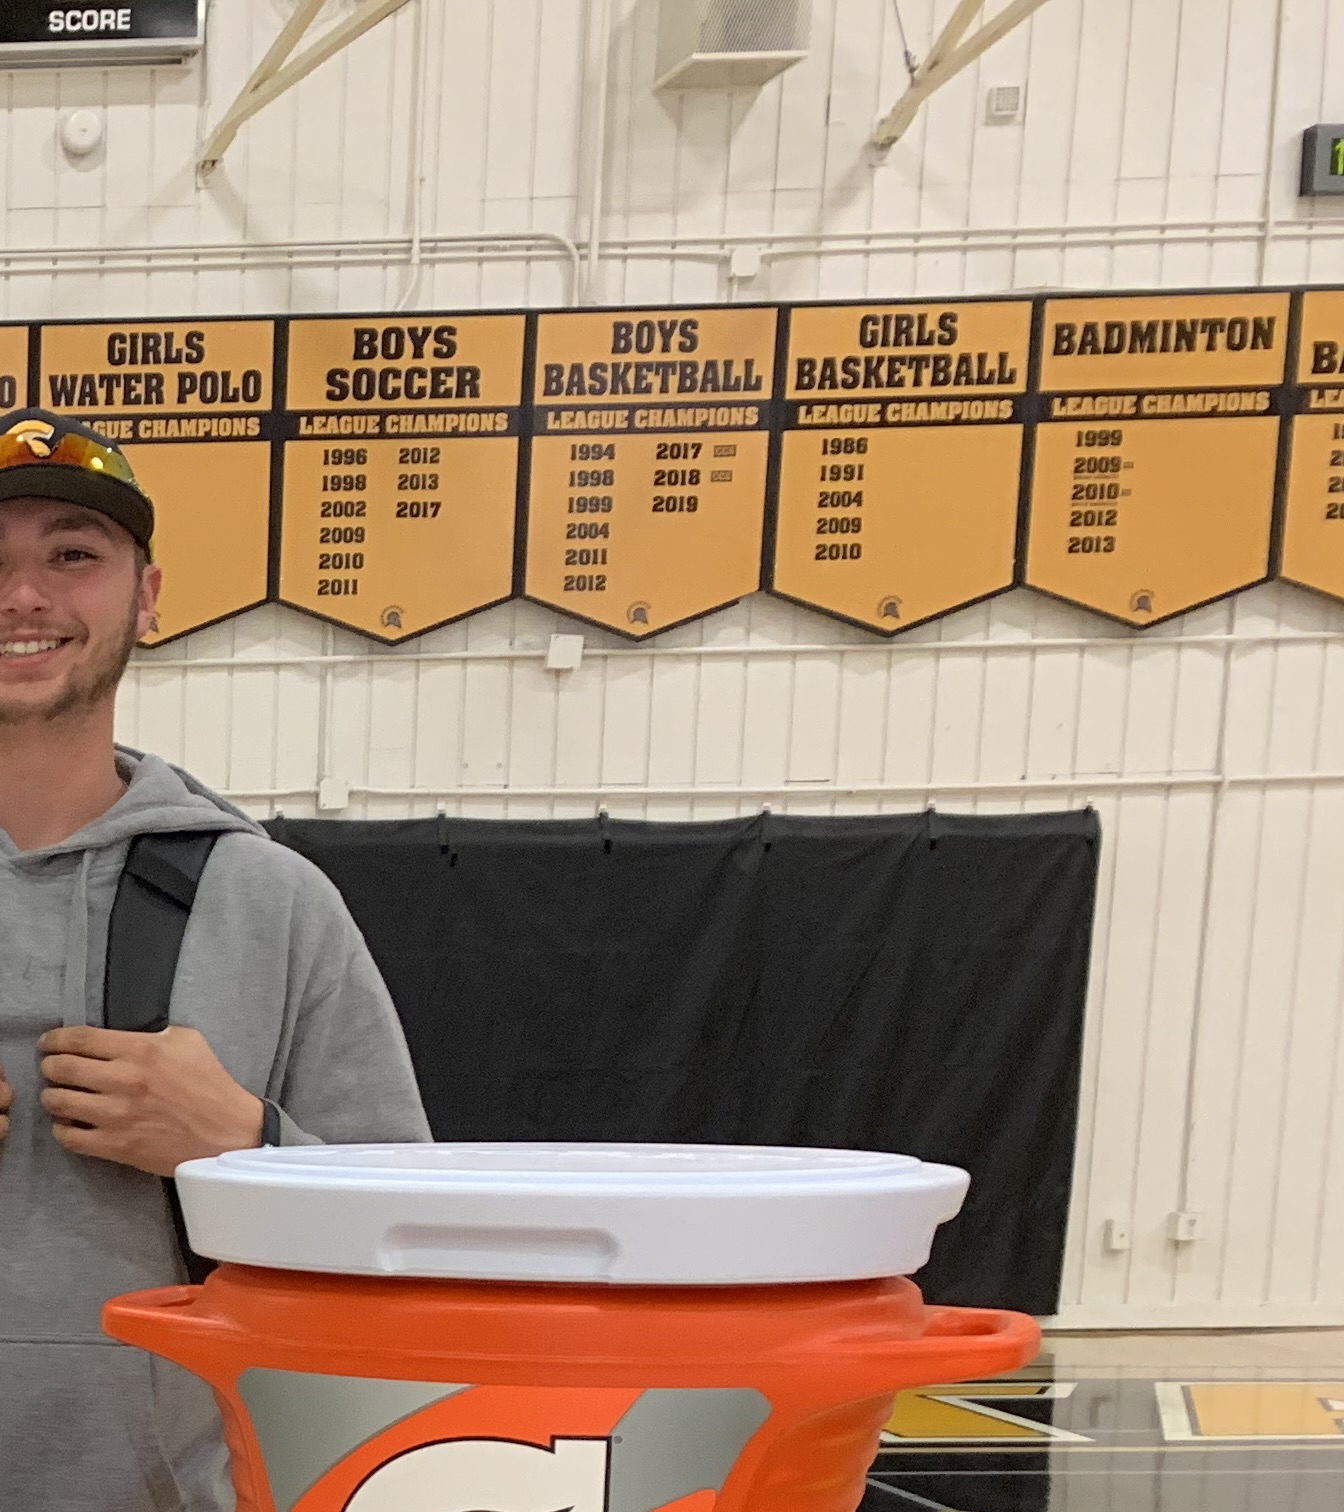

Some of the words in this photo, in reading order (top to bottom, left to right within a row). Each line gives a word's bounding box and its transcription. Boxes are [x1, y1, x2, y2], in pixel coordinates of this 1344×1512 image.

[48, 9, 131, 32] SCORE
[353, 325, 457, 360] BOYS
[612, 319, 698, 354] BOYS
[859, 313, 958, 348] GIRLS
[1053, 315, 1277, 357] BADMINTON
[107, 331, 206, 366] GIRLS
[49, 372, 164, 407] WATER
[177, 369, 262, 405] POLO
[326, 366, 481, 401] SOCCER
[543, 359, 763, 396] BASKETBALL
[795, 352, 1017, 391] BASKETBALL
[299, 415, 380, 435] LEAGUE
[386, 412, 508, 433] CHAMPIONS
[322, 449, 367, 466] 1996
[398, 448, 440, 464] 2012
[1067, 536, 1116, 554] 2013
